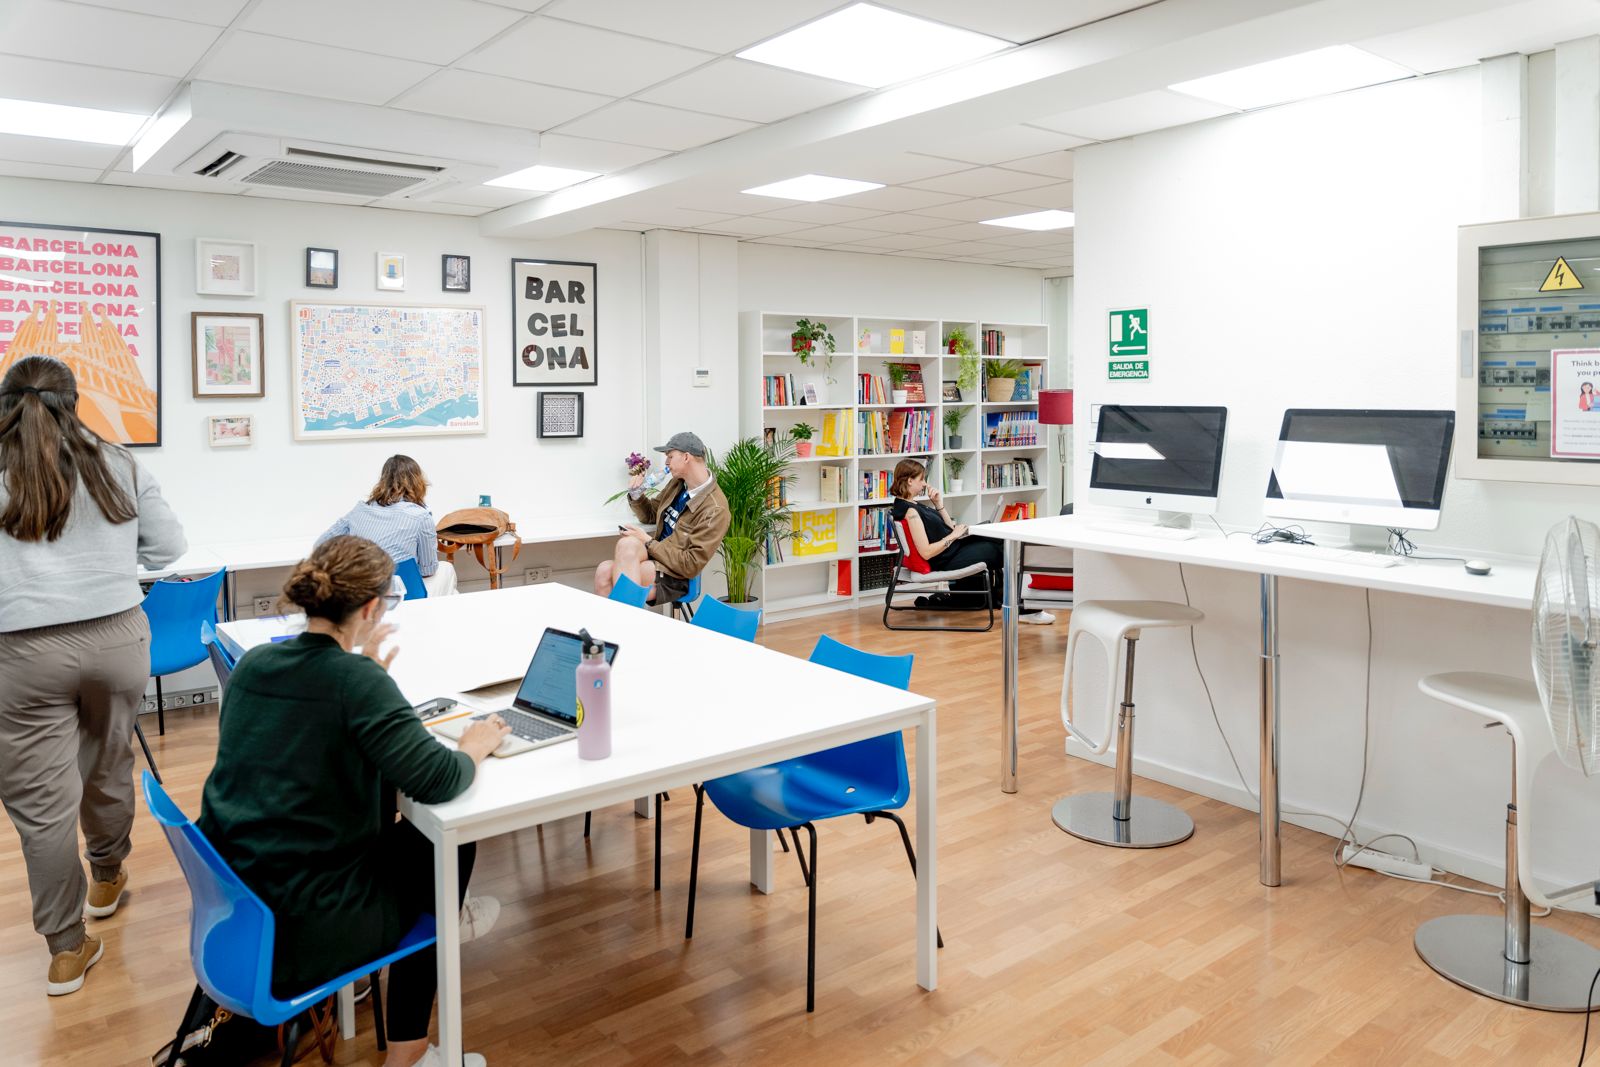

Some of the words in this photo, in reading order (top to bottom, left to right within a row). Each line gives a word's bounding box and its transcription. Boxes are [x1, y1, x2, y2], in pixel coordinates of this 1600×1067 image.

[0, 236, 139, 258] BARCELONA
[0, 257, 139, 279] BARCELONA
[525, 276, 586, 304] BAR
[527, 312, 584, 337] CEL
[521, 344, 589, 370] ONA
[802, 508, 835, 527] Find
